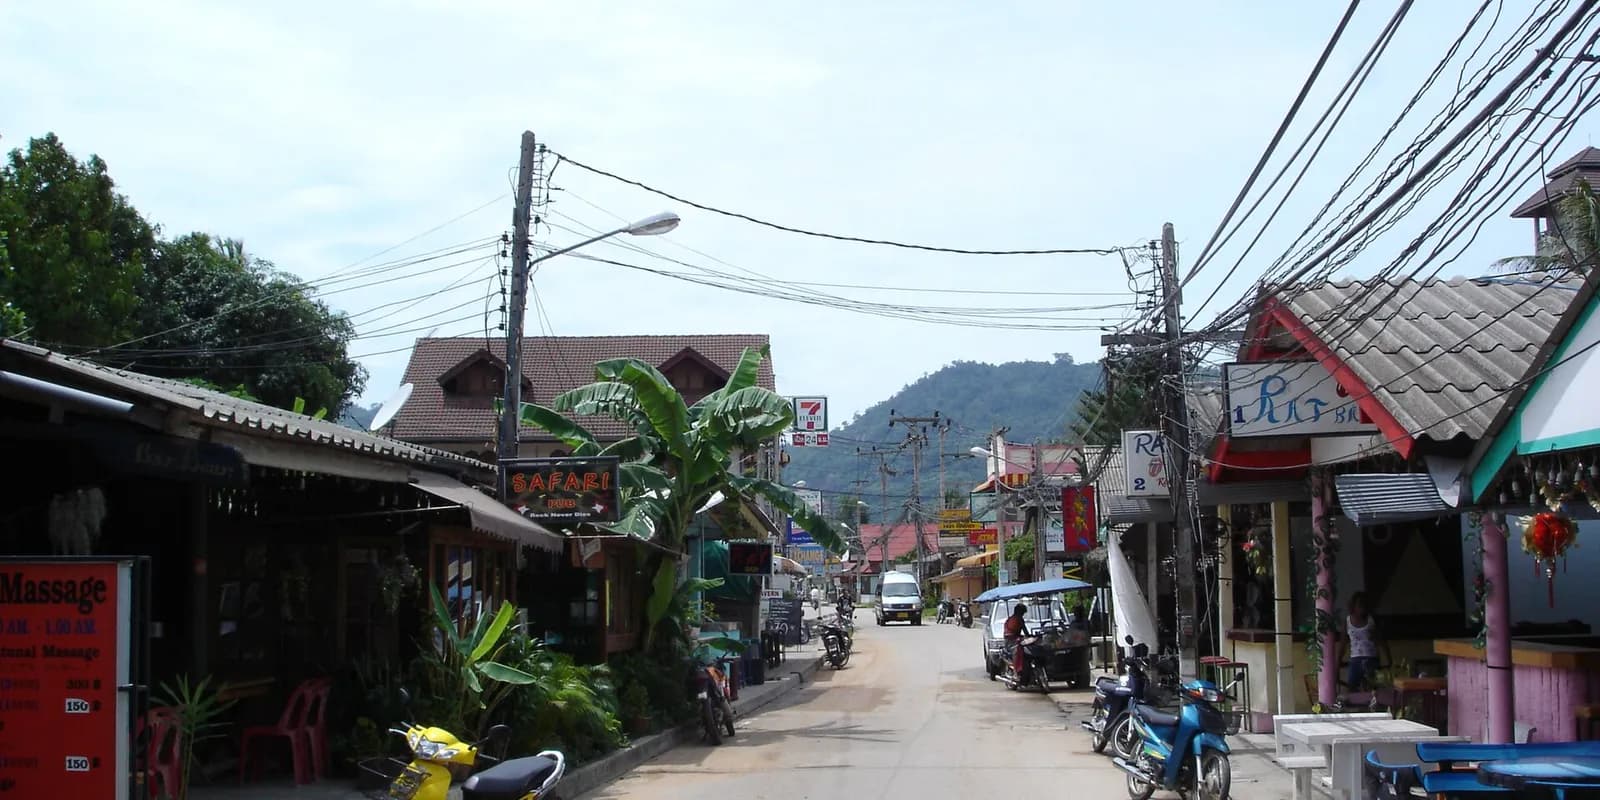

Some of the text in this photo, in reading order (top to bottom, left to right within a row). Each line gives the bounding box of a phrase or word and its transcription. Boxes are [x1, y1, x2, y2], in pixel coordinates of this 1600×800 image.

[1233, 374, 1360, 425] 1 RAT BA
[800, 401, 821, 416] 7
[806, 435, 817, 446] 24
[1133, 432, 1165, 457] RA
[511, 472, 610, 494] SAFARI
[1134, 477, 1146, 490] 2
[547, 498, 577, 509] PUB
[529, 511, 549, 519] Rock
[574, 510, 591, 518] Dies
[0, 571, 107, 614] Massage
[66, 701, 88, 712] 150
[66, 758, 88, 769] 150
